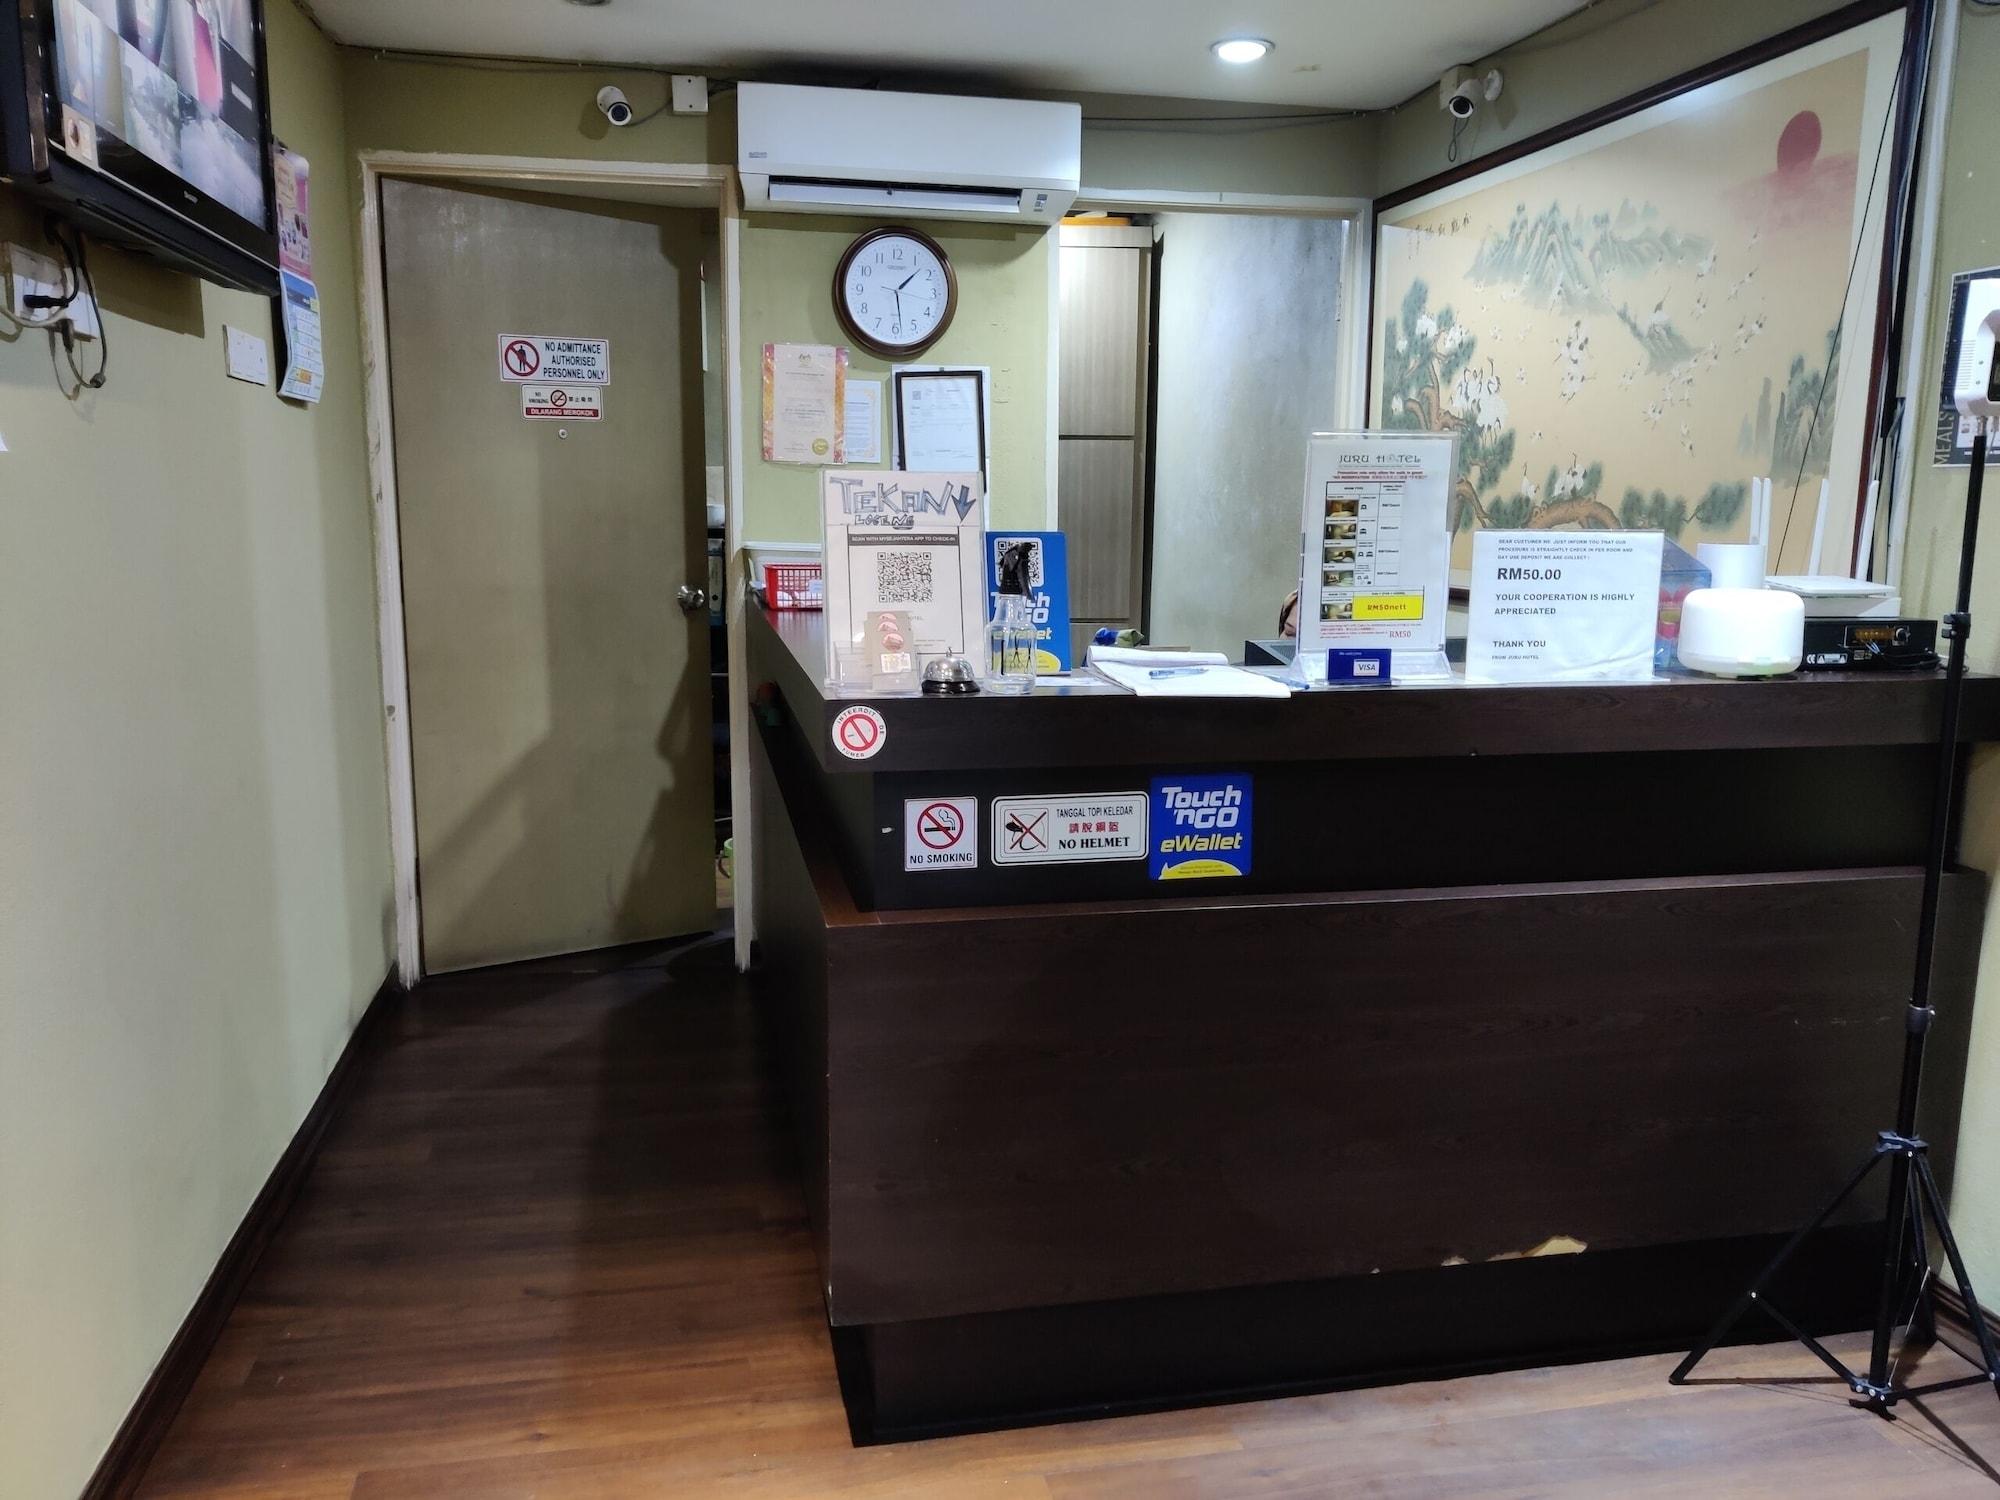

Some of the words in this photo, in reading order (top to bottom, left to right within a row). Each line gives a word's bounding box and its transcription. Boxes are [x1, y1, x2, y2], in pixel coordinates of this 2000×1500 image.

[875, 252, 884, 264] 11
[893, 248, 903, 260] 12
[913, 255, 917, 267] 1
[861, 265, 872, 277] 10
[925, 269, 932, 281] 2
[855, 284, 864, 296] 9
[930, 288, 937, 300] 3
[860, 302, 868, 314] 8
[923, 306, 930, 317] 4
[875, 317, 882, 329] 7
[891, 323, 900, 335] 6
[910, 319, 918, 332] 5
[545, 341, 555, 351] NO
[557, 342, 601, 354] ADMITTANCE
[551, 355, 596, 366] AUTHORISED
[543, 367, 585, 379] PERSONNEL
[587, 369, 604, 380] ONLY
[829, 476, 954, 515] TEKAN
[1497, 568, 1562, 580] RM50.00
[1496, 593, 1520, 601] YOUR
[1523, 593, 1588, 601] COOPERATION
[1590, 593, 1599, 601] IS
[1601, 593, 1635, 601] HIGHLY
[1494, 607, 1556, 615] APPRECIATED
[1389, 630, 1411, 638] RM50
[1492, 640, 1524, 648] THANK
[1527, 640, 1546, 648] YOU
[1358, 663, 1376, 671] VISA
[1161, 784, 1243, 809] Touch
[1056, 808, 1086, 818] TANGGAL
[1088, 807, 1102, 816] TOPI
[1103, 805, 1134, 816] KELEDAR
[1058, 839, 1077, 850] NO
[1080, 836, 1130, 849] HELMET
[1160, 832, 1243, 853] eWallet
[910, 855, 924, 864] NO
[927, 852, 973, 864] SMOKING
